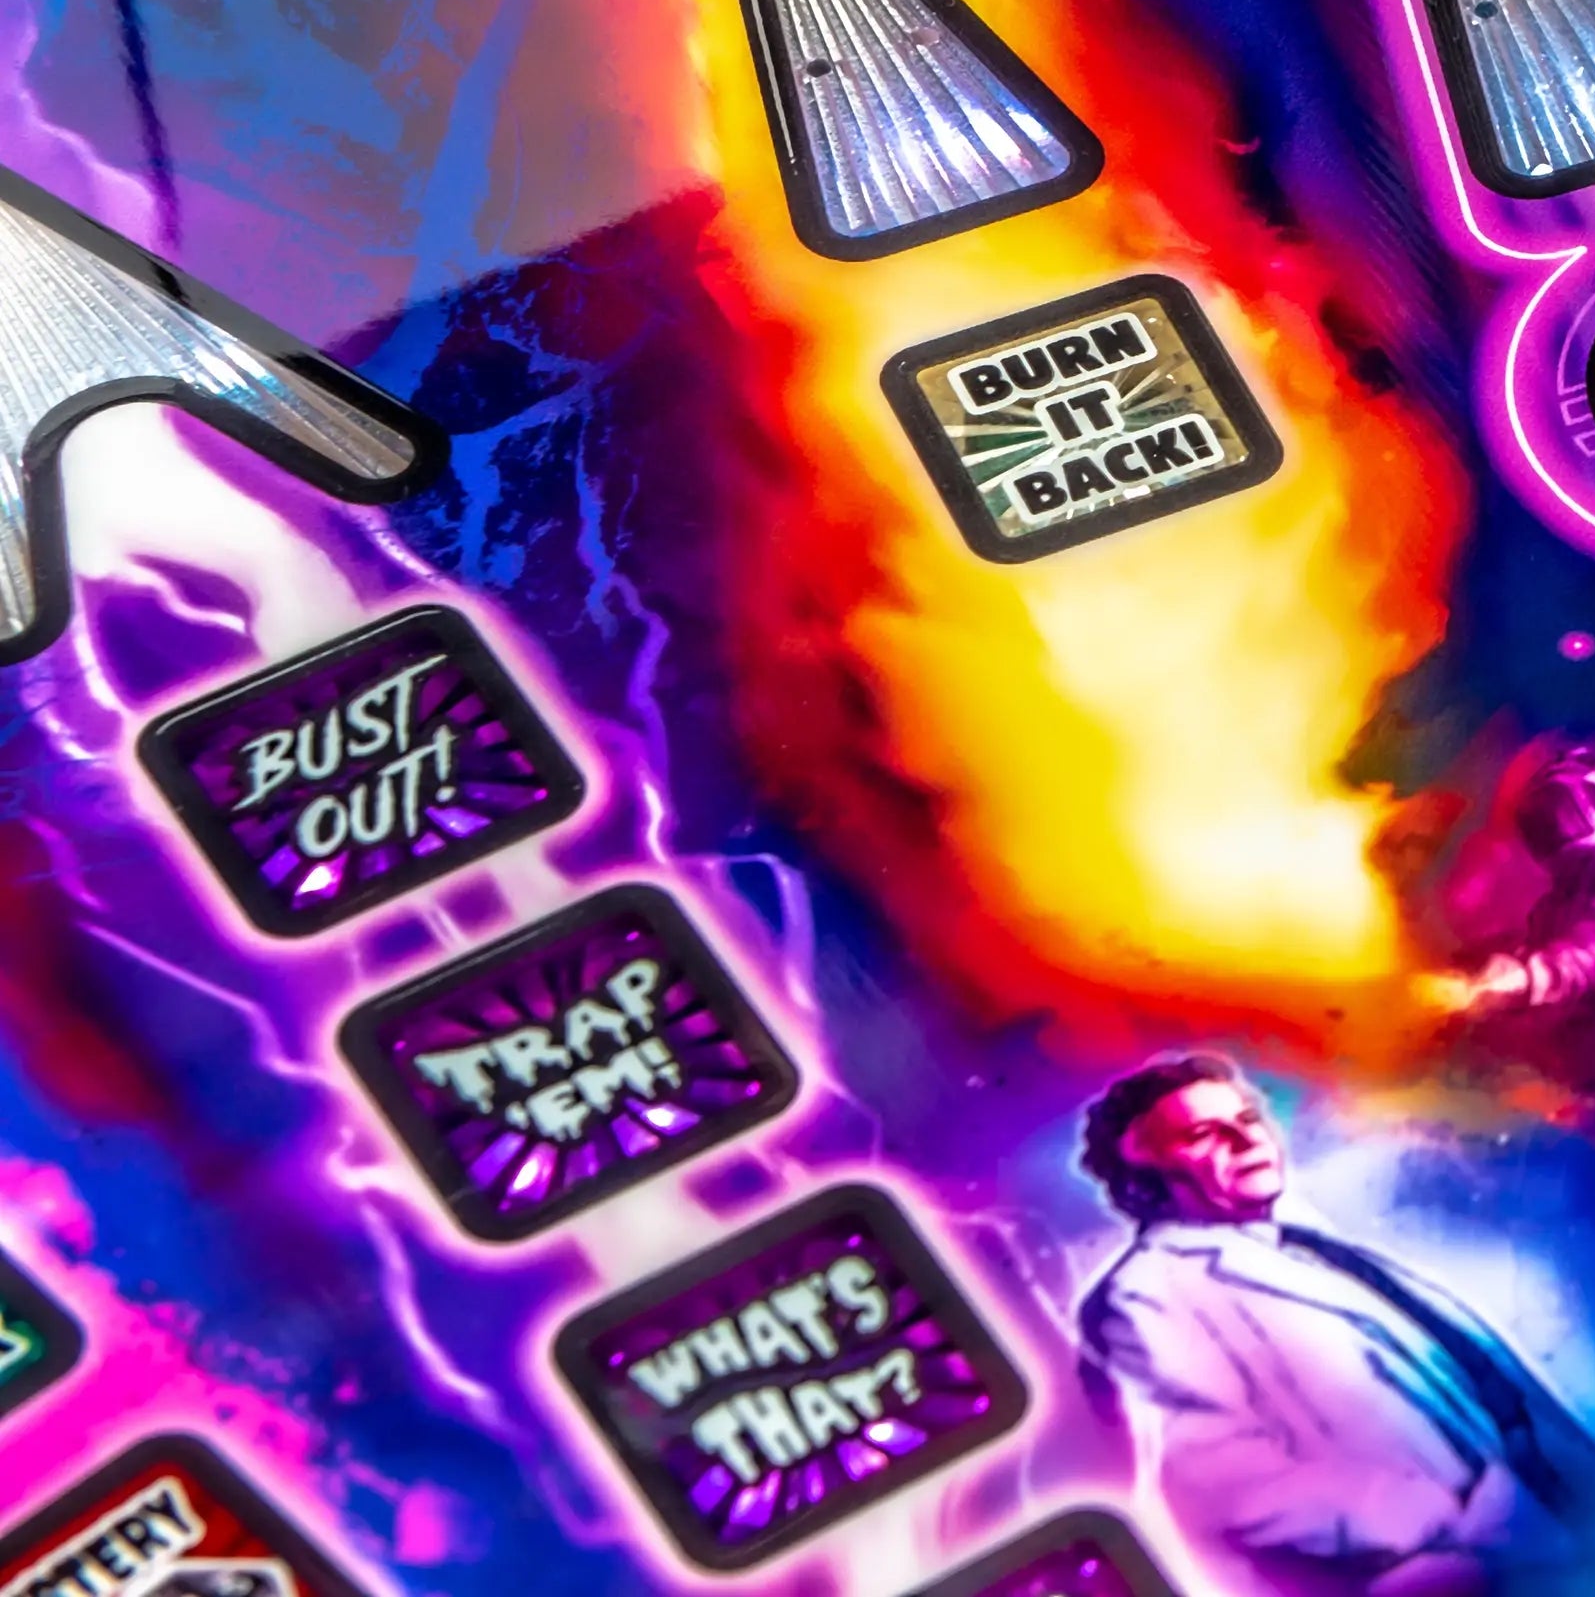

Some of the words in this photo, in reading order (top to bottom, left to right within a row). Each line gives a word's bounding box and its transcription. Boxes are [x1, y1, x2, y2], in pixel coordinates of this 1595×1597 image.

[959, 319, 1147, 406] BURN
[1046, 388, 1114, 442] IT
[1013, 419, 1214, 515] BACK!
[232, 654, 447, 810] BUST
[297, 725, 459, 856] OUT!
[414, 959, 660, 1115] TRAP
[505, 1038, 681, 1142] 'EM!
[628, 1255, 889, 1408] WHAT'S
[692, 1349, 923, 1483] THAT?
[28, 1488, 191, 1597] TERY
